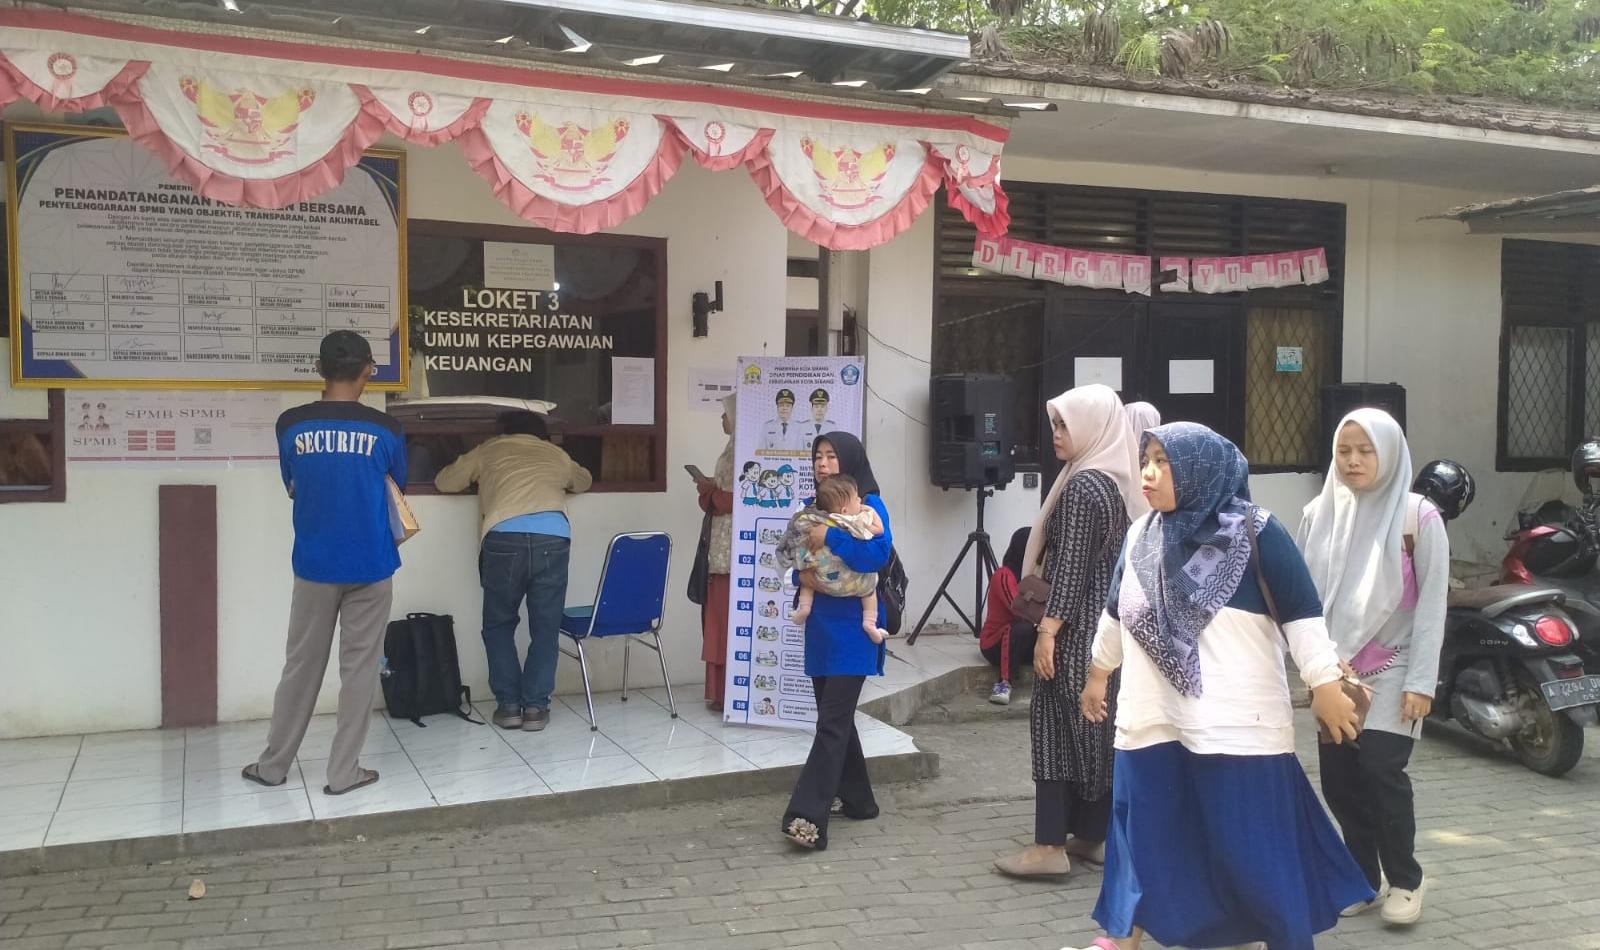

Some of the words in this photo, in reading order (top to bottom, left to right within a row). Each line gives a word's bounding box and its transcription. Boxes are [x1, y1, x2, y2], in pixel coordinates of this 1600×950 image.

[54, 187, 212, 207] PENANDATANGANAN
[299, 202, 366, 216] BERSAMA
[39, 200, 137, 212] PENYELENGGARAAN
[139, 205, 166, 214] SPMB
[168, 206, 194, 216] YANG
[196, 208, 242, 220] OBJEKTIF,
[245, 211, 307, 223] TRANSPARAN,
[309, 215, 327, 224] DAN
[329, 217, 381, 227] AKUNTABEL
[463, 289, 541, 310] LOKET
[548, 292, 560, 311] 3
[424, 311, 593, 330] KESEKRETARIATAN
[424, 331, 480, 348] UMUM
[487, 334, 613, 350] KEPEGAWAIAN
[424, 355, 532, 373] KEUANGAN
[124, 409, 174, 420] SPMB
[179, 408, 227, 418] SPMB
[72, 436, 118, 446] SPMB
[295, 430, 378, 456] SECURITY
[1548, 685, 1556, 697] A
